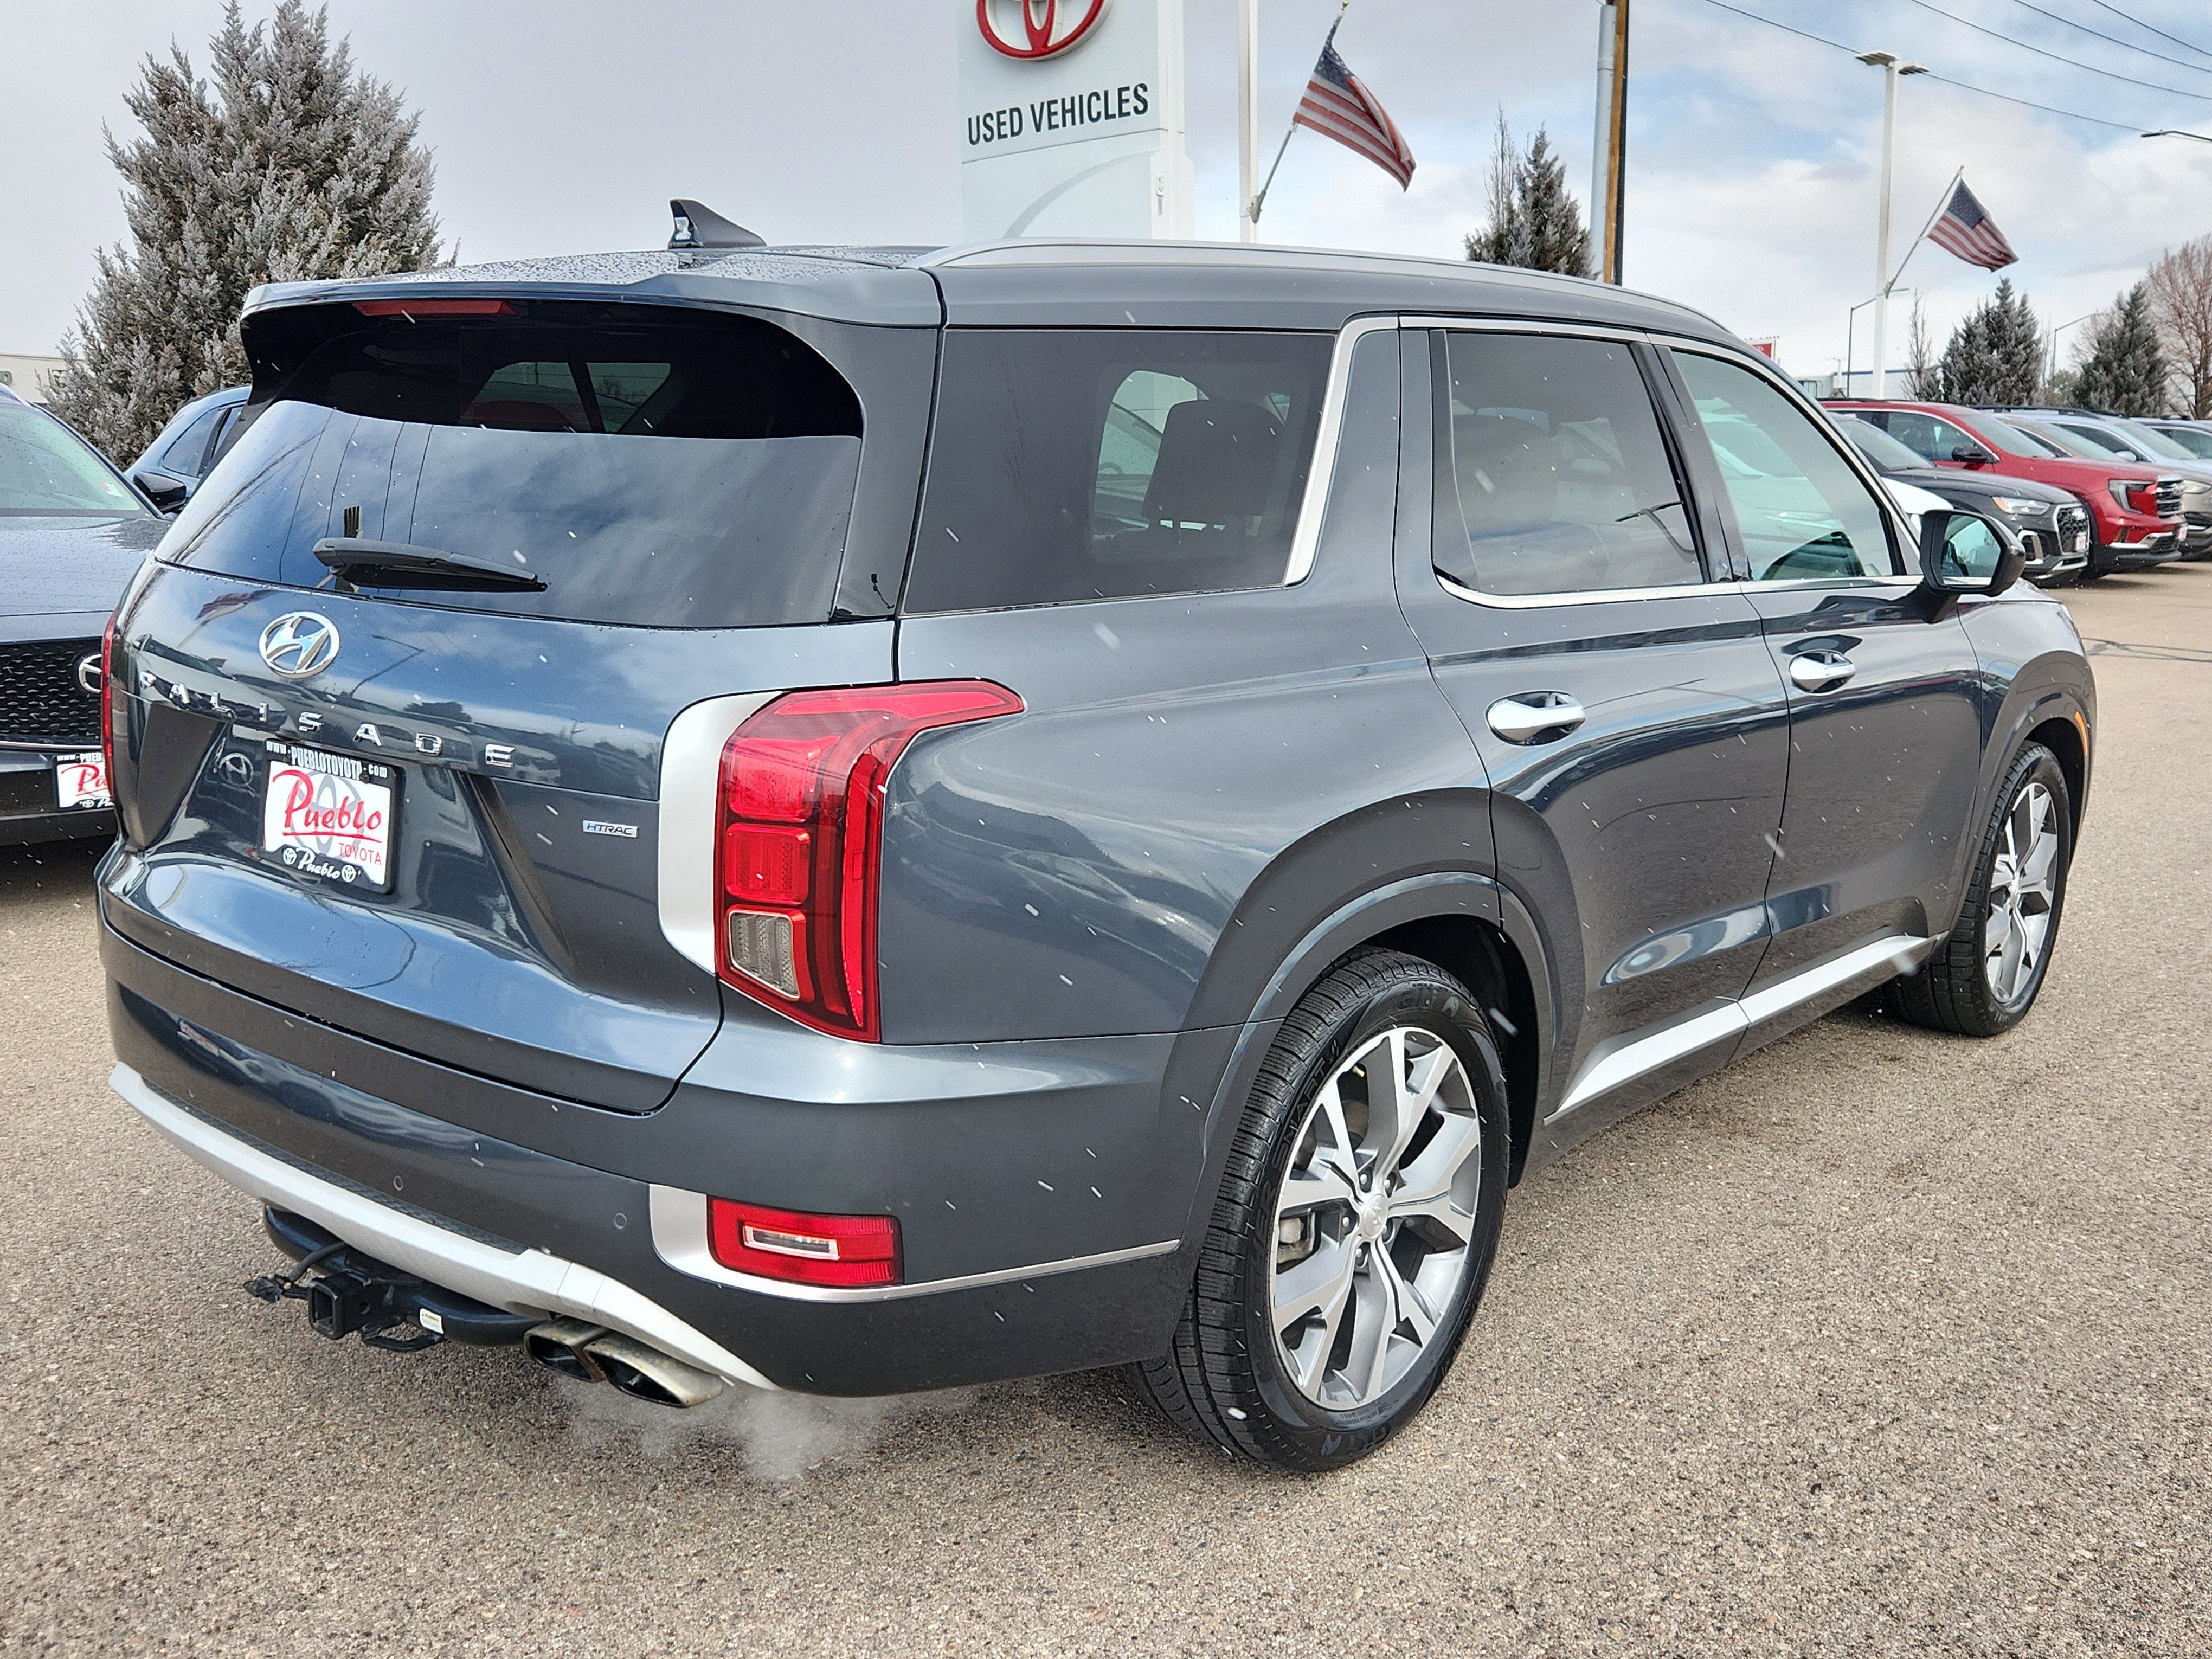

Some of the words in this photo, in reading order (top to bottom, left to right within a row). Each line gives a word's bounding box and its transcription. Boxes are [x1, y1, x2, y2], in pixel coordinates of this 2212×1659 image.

[968, 107, 1023, 146] USED
[1031, 83, 1149, 133] VEHICLES
[139, 670, 516, 768] PALISADE
[272, 769, 382, 831] Pueblo
[587, 822, 633, 835] HTRAC
[295, 846, 340, 880] Pueblo
[339, 842, 382, 866] TOYOTA
